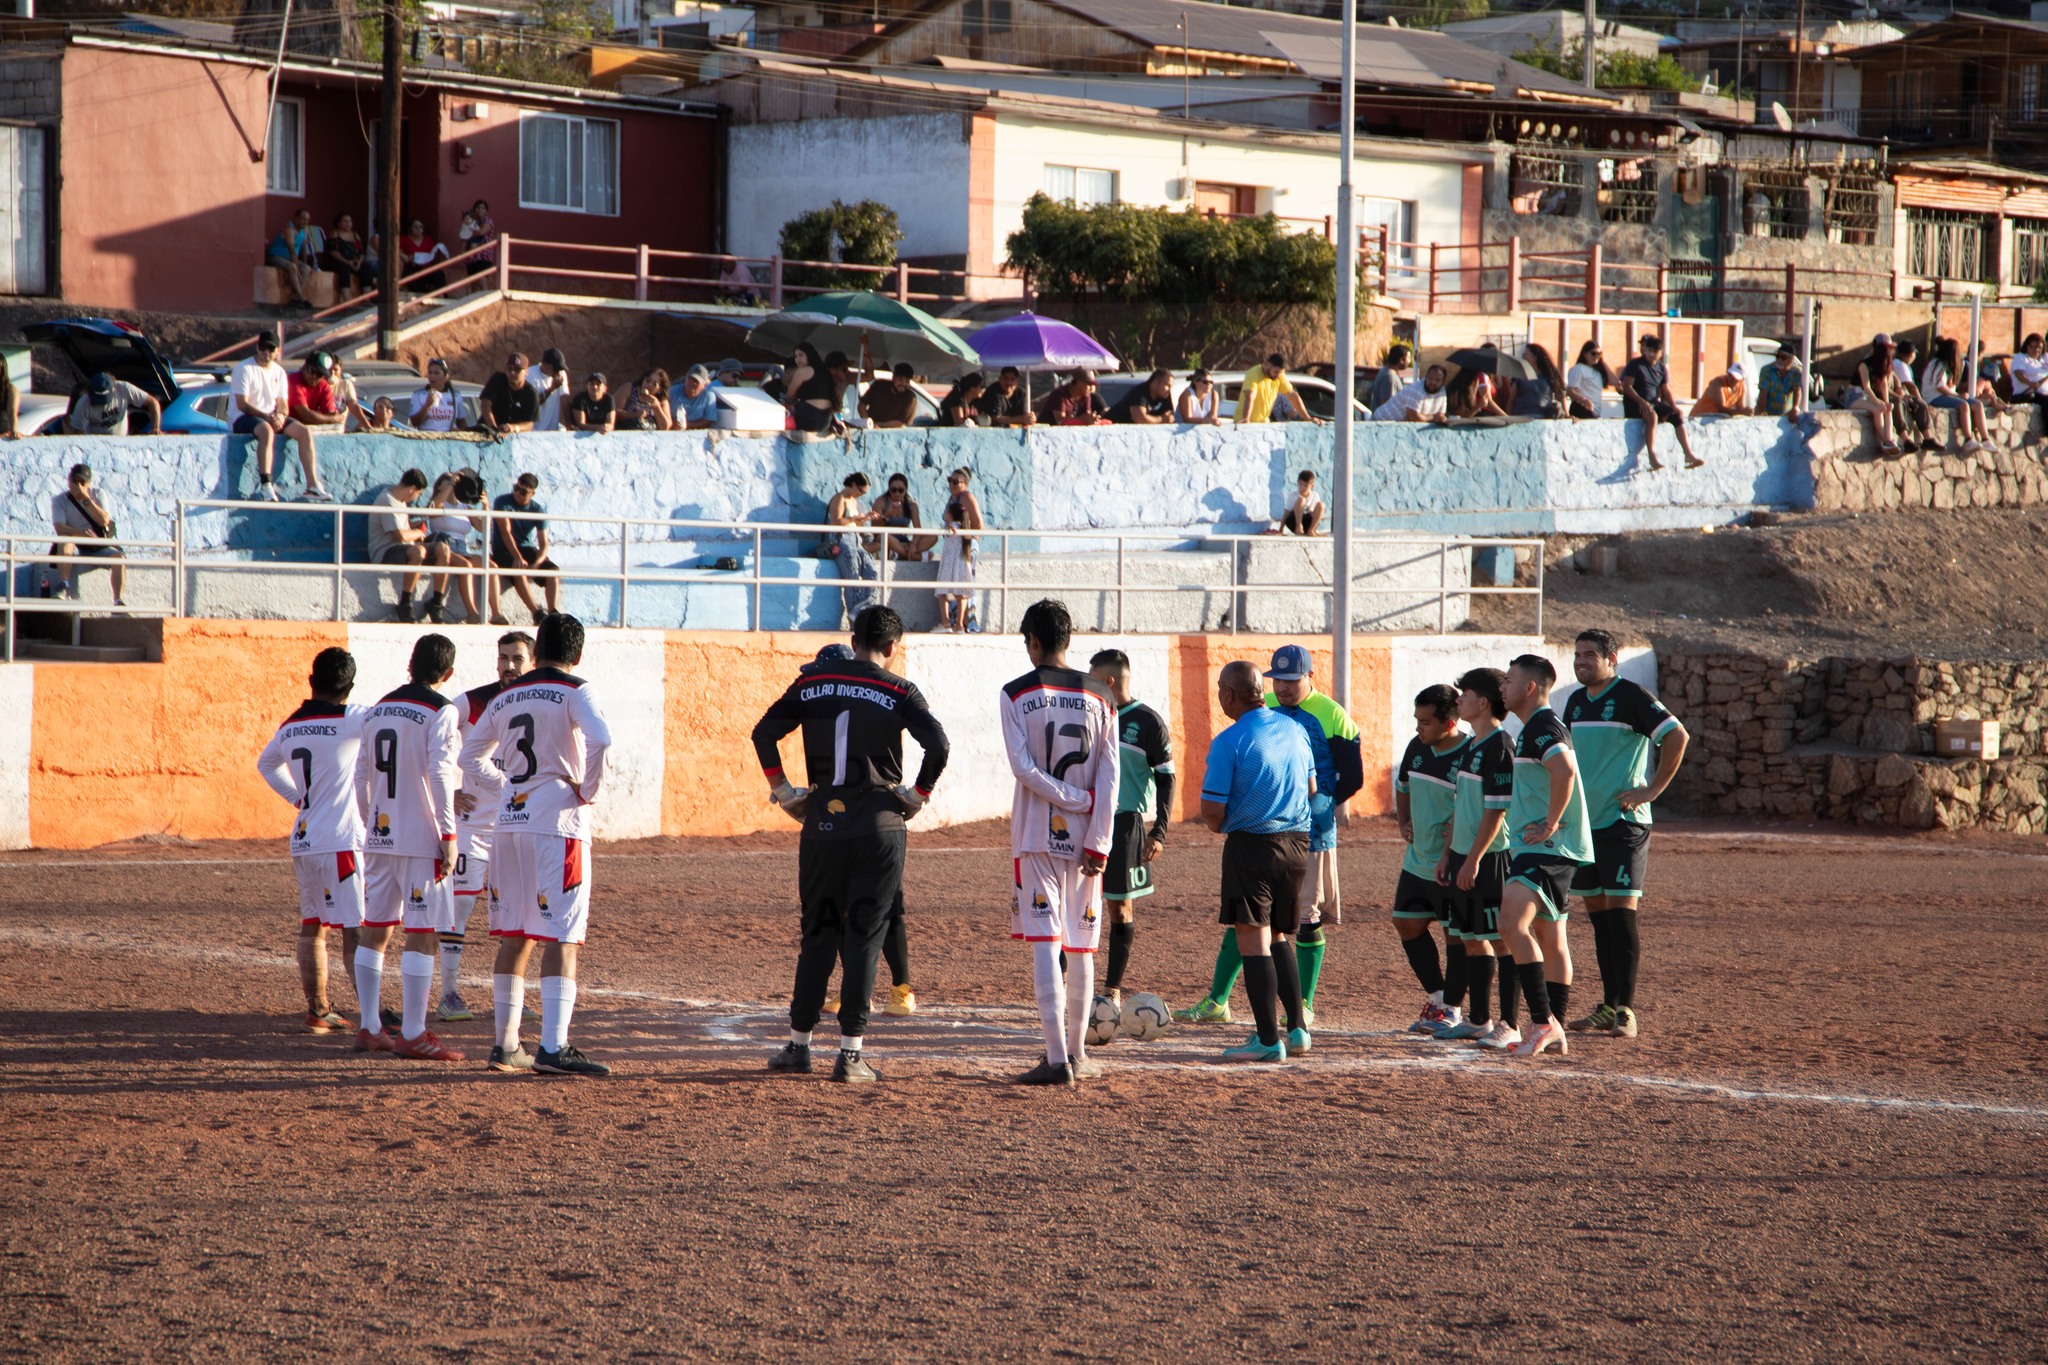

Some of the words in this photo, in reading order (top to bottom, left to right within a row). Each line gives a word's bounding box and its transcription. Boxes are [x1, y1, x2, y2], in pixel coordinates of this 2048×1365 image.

[516, 688, 565, 704] INVERSIONES
[800, 684, 834, 701] COLLAO
[836, 684, 897, 711] INVERSIONES
[1022, 696, 1058, 714] COLLAO
[384, 706, 427, 725] INVERSIONES
[293, 725, 337, 736] INVERSIONES
[508, 713, 538, 785] 3
[832, 709, 850, 787] 1
[1045, 721, 1090, 782] 12
[375, 728, 398, 799] 9
[291, 747, 312, 810] 7
[1128, 866, 1147, 889] 10
[1614, 864, 1631, 887] 4
[1484, 907, 1500, 930] 11
